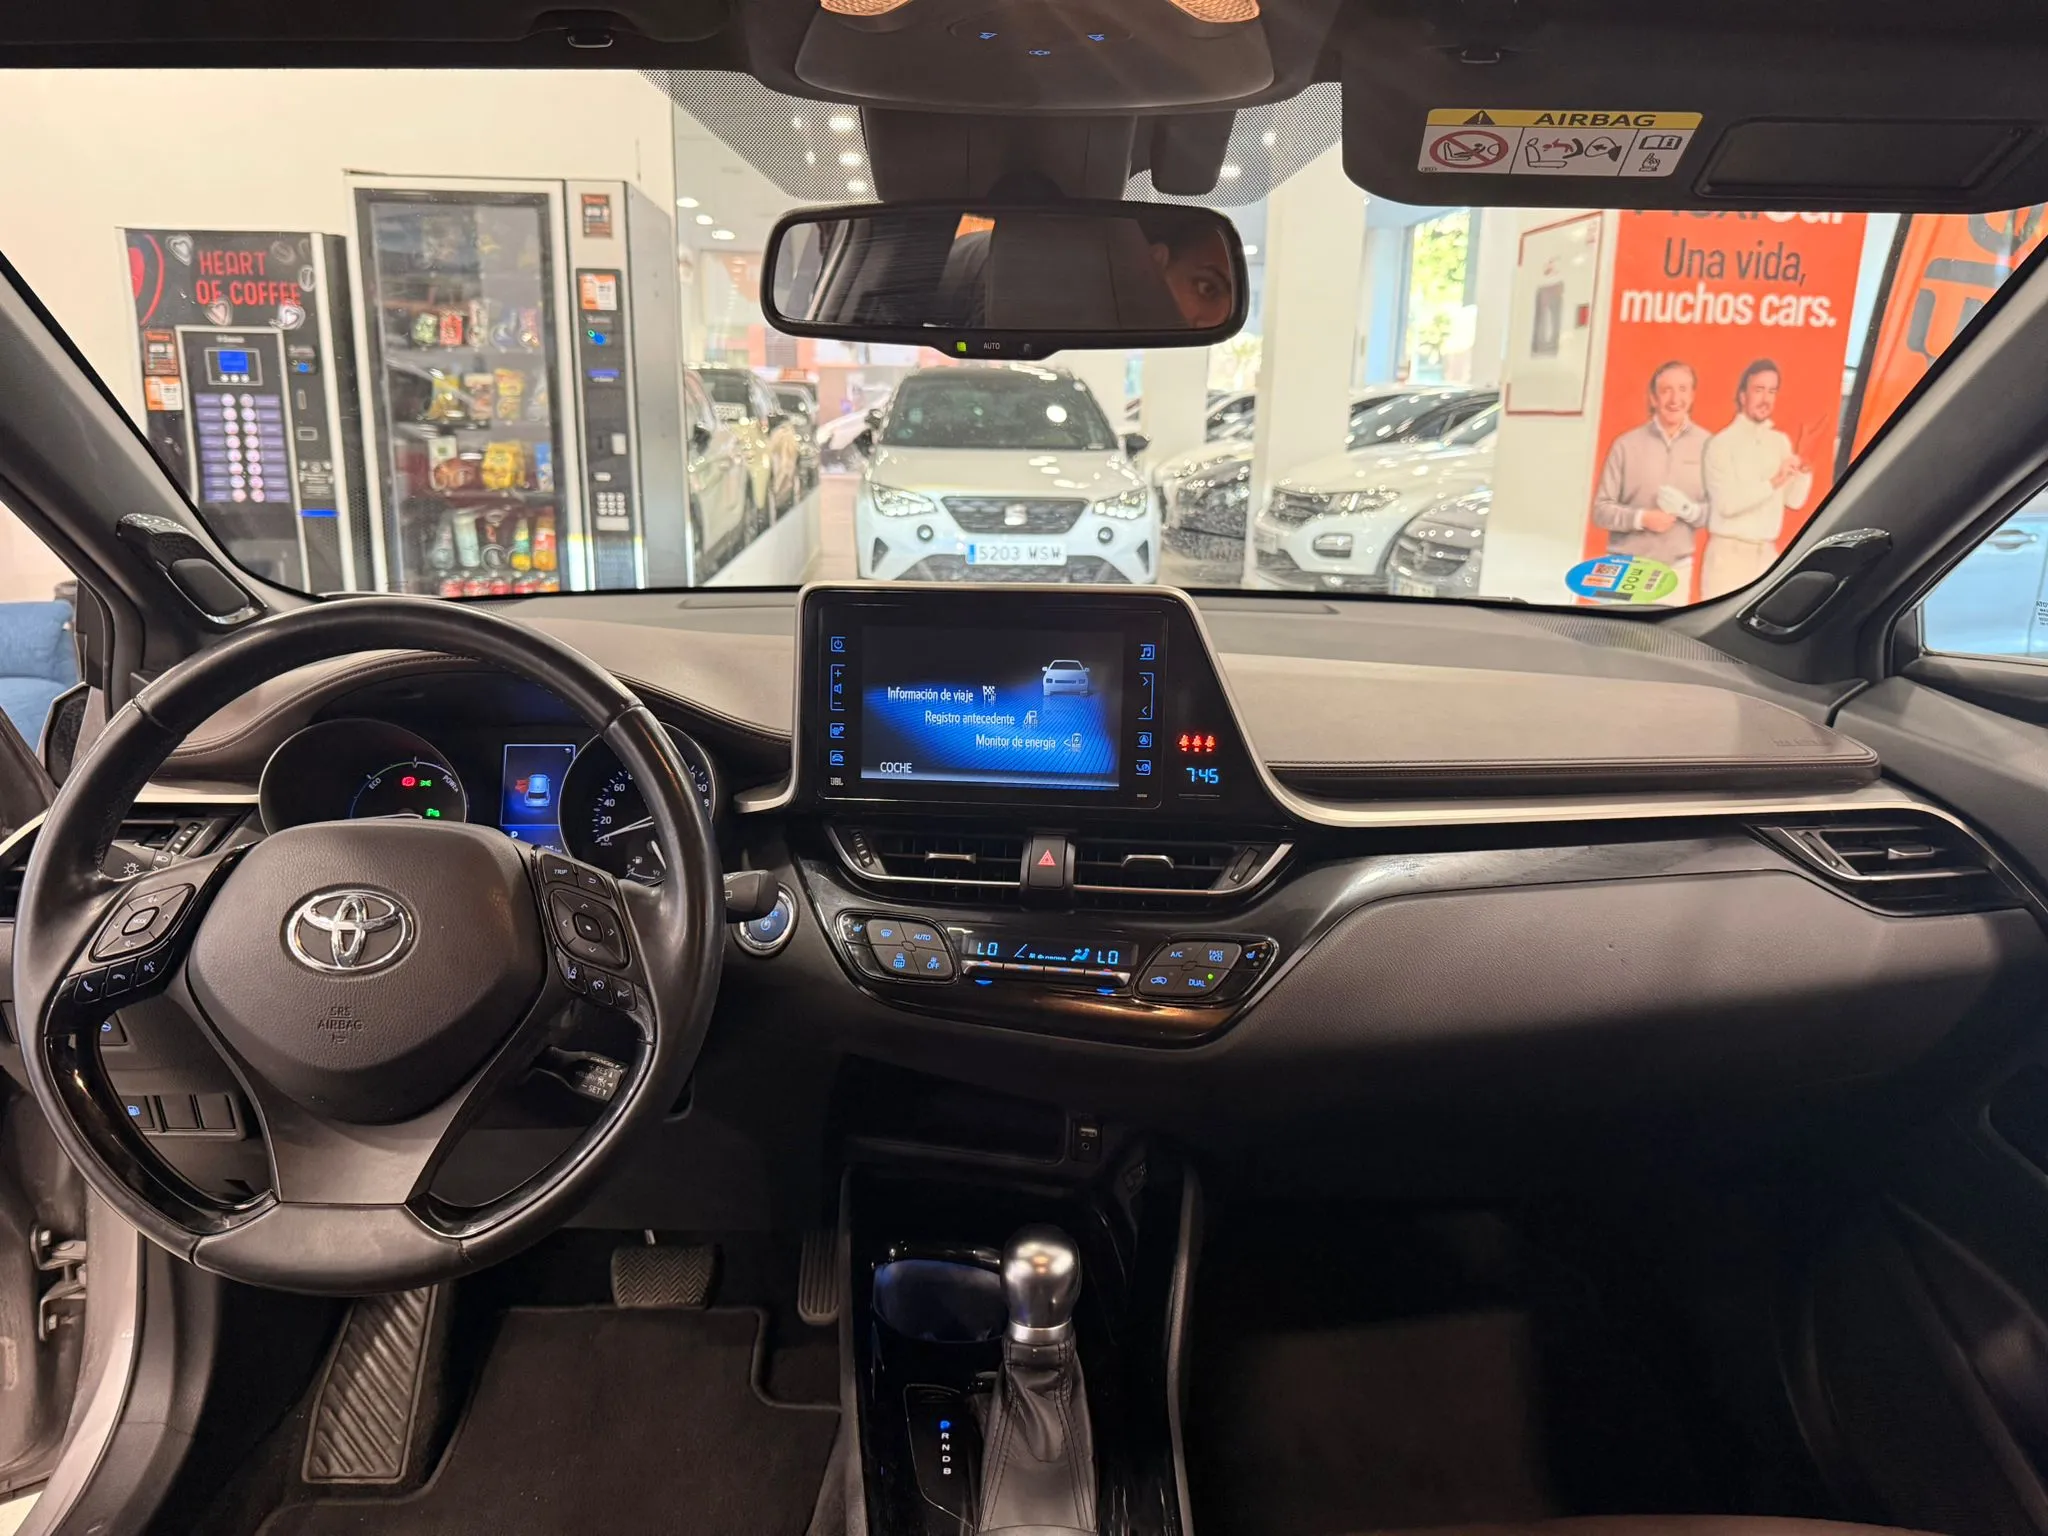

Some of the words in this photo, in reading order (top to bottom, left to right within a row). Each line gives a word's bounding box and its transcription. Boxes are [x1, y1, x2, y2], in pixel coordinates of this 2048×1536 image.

[1534, 113, 1656, 126] AIRBAG
[200, 251, 267, 275] HEART
[1664, 238, 1724, 278] Una
[1737, 239, 1806, 286] vida,
[196, 280, 222, 305] OF
[229, 282, 302, 306] COFFEE
[1620, 281, 1753, 325] muchos
[1760, 293, 1837, 328] cars.
[983, 342, 1000, 350] AUTO
[979, 545, 1021, 561] 5203
[887, 686, 938, 701] Información
[940, 688, 951, 701] de
[953, 690, 974, 703] viaje
[925, 710, 960, 725] Registro
[963, 712, 1015, 725] antecedente
[976, 733, 1010, 748] Monitor
[1012, 736, 1023, 748] de
[1025, 738, 1056, 751] energía
[880, 761, 912, 774] COCHE
[1186, 767, 1219, 784] 7:45
[368, 778, 382, 790] ECO
[830, 777, 844, 786] JBL
[614, 783, 625, 792] 60
[604, 798, 615, 807] 40
[600, 816, 612, 825] 20
[511, 830, 519, 838] P
[913, 933, 931, 941] AUTO
[977, 942, 998, 956] LO
[1097, 950, 1119, 965] LO
[927, 961, 940, 970] OFF
[1188, 978, 1207, 988] DUAL
[330, 1006, 352, 1016] SRS
[317, 1019, 363, 1031] AIRBAG
[596, 1065, 609, 1076] RES
[588, 1084, 601, 1095] SET
[941, 1432, 949, 1440] R
[942, 1455, 951, 1463] D
[943, 1467, 952, 1475] B
